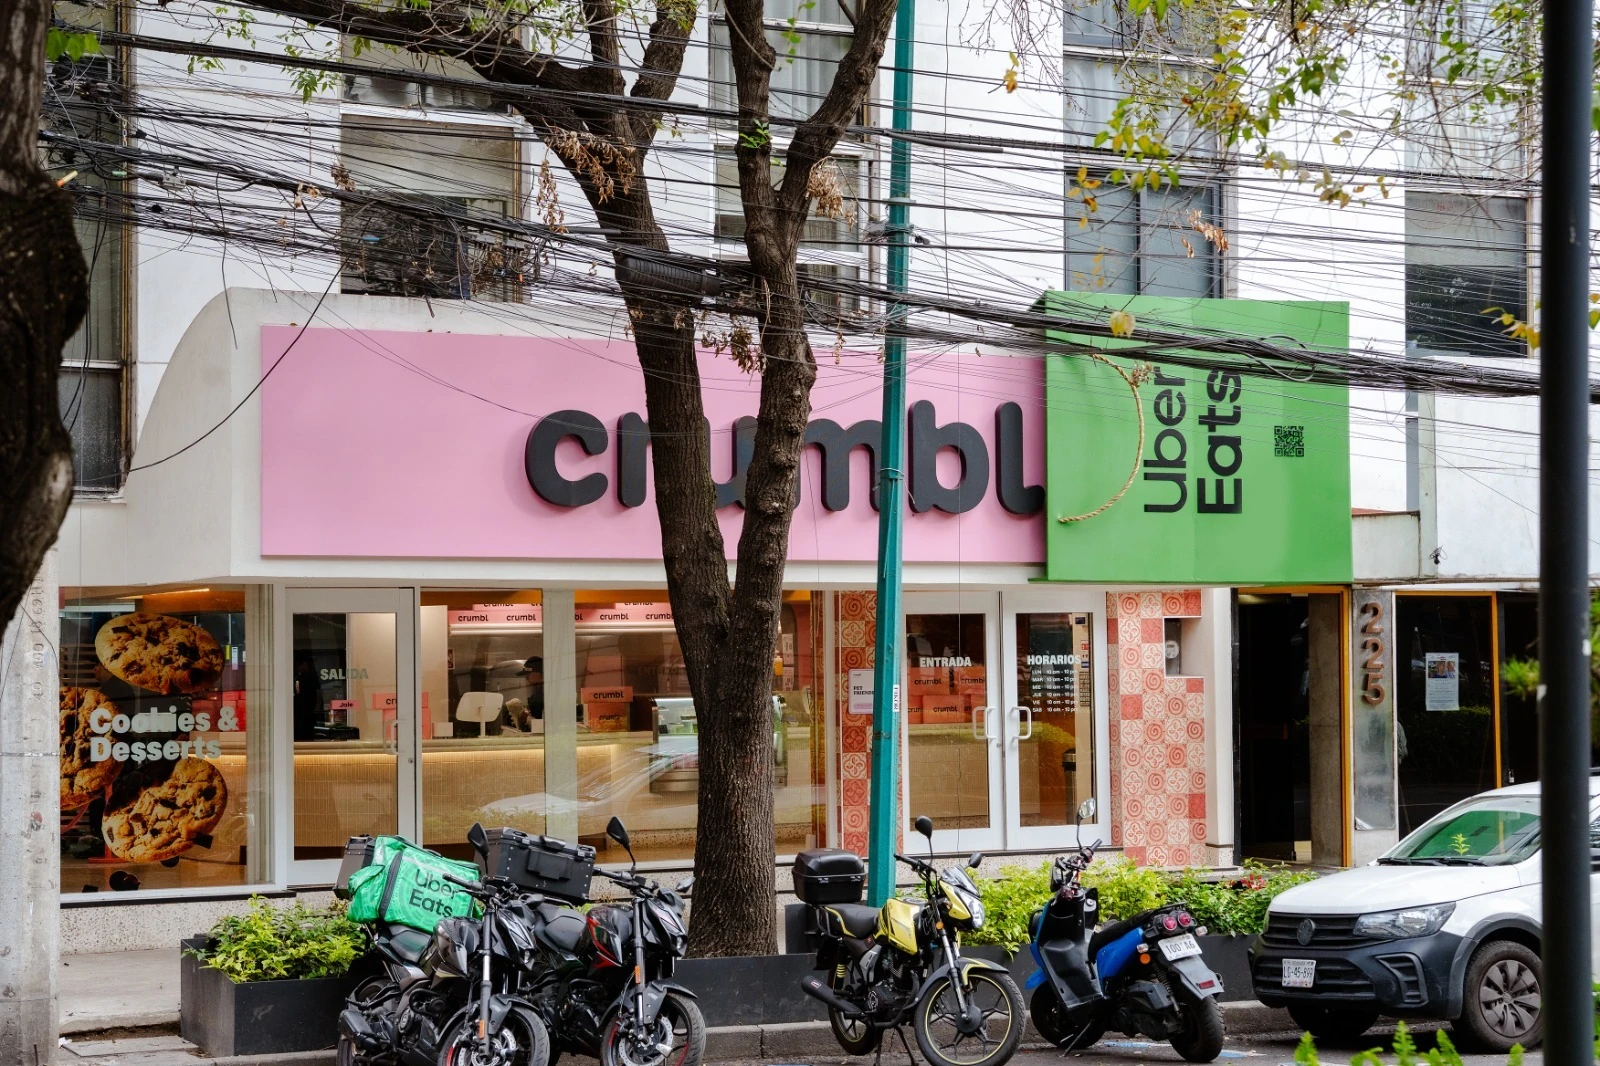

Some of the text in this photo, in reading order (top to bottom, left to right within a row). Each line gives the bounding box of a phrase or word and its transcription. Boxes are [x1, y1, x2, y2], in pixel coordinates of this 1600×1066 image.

[1144, 366, 1187, 513] Uber
[1197, 368, 1243, 514] Eats
[525, 399, 1046, 515] crumbl
[457, 613, 537, 622] crumbl crumbl
[599, 612, 629, 620] crumbl
[919, 656, 972, 668] ENTRADA
[1026, 654, 1081, 665] HORARIOS
[1361, 602, 1386, 706] 225
[320, 668, 369, 680] SALIDA
[593, 691, 624, 699] crumbl
[89, 705, 239, 734] Cookies &
[933, 705, 958, 713] crumbl
[90, 736, 221, 762] Desserts
[415, 869, 455, 900] Uber
[409, 888, 453, 918] Eats
